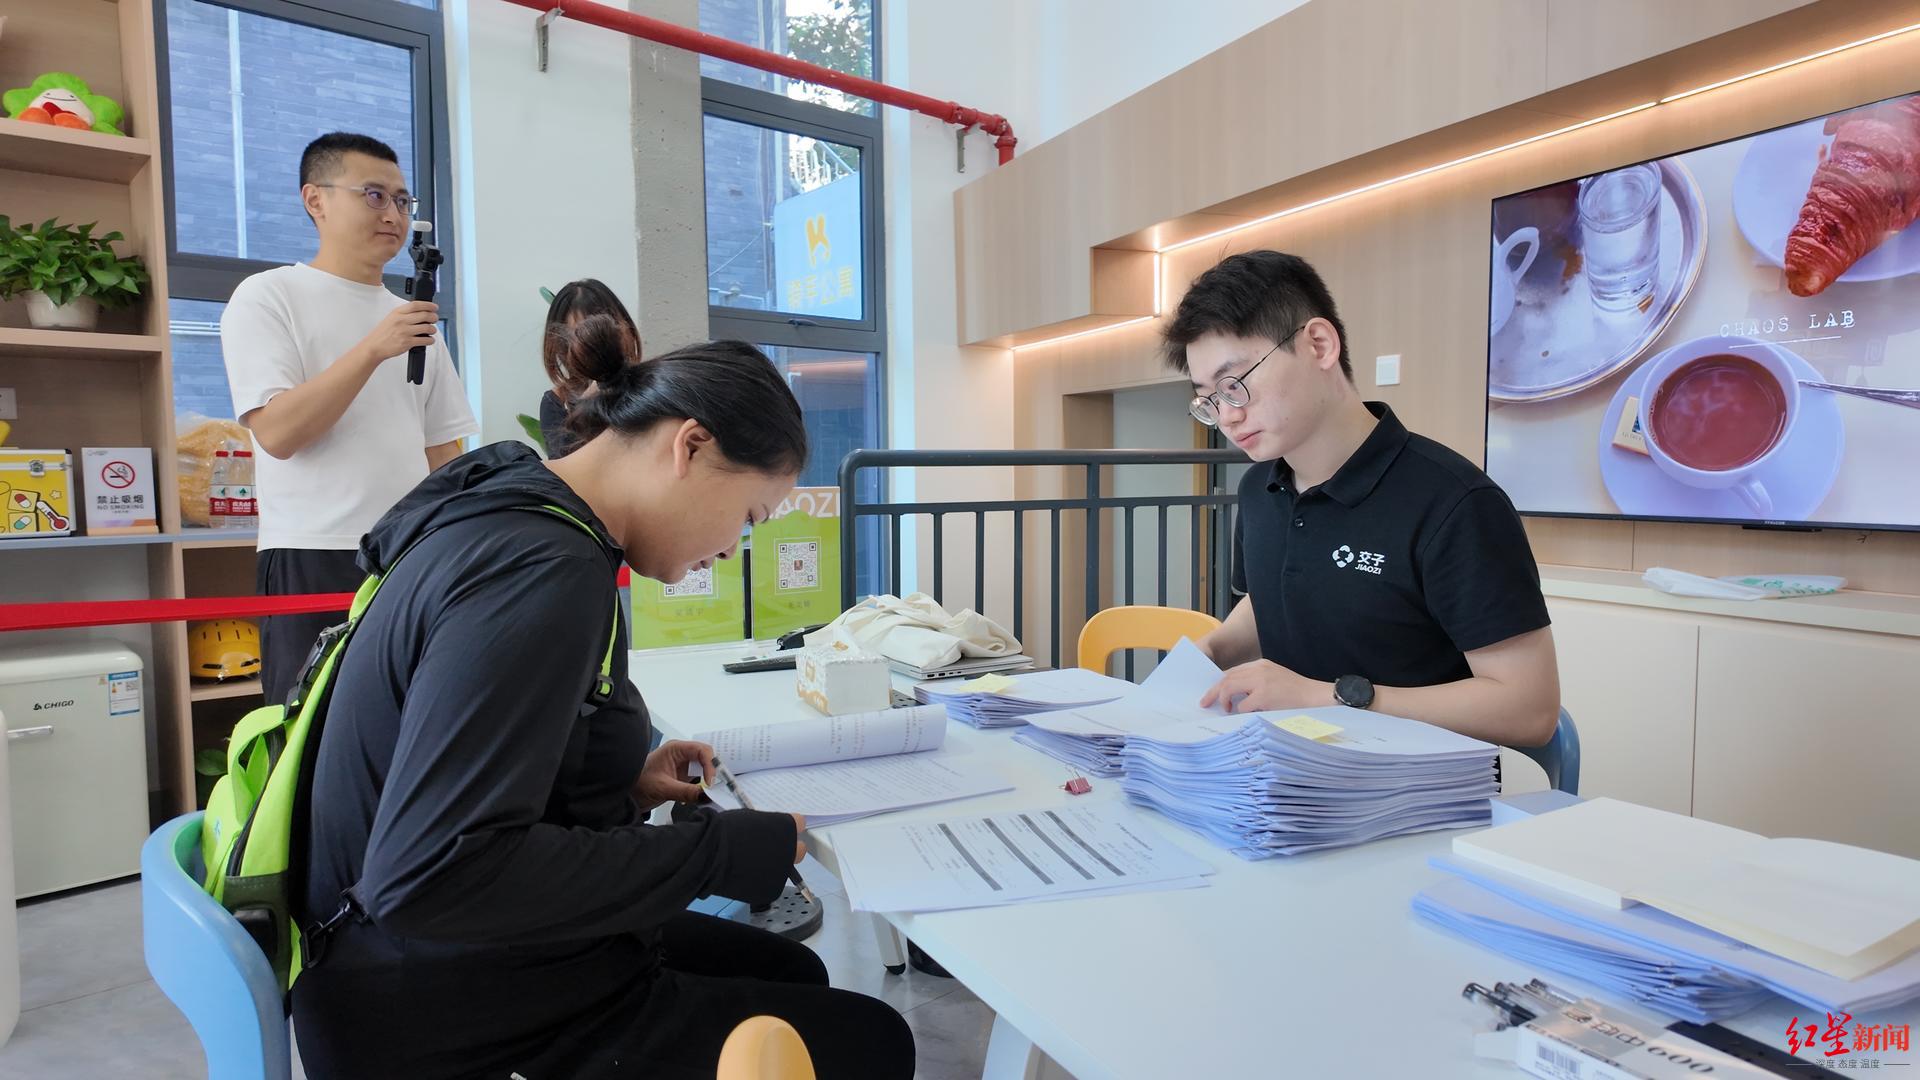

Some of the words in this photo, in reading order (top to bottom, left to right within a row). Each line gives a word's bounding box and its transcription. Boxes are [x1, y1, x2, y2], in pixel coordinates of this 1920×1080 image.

[1719, 315, 1790, 338] CHAOS
[1808, 310, 1856, 329] LAB
[97, 494, 144, 504] 禁止吸烟
[769, 492, 840, 519] AOZI
[1357, 551, 1385, 567] 交子
[1355, 564, 1382, 575] JIAOZI
[44, 700, 74, 709] CHIGO
